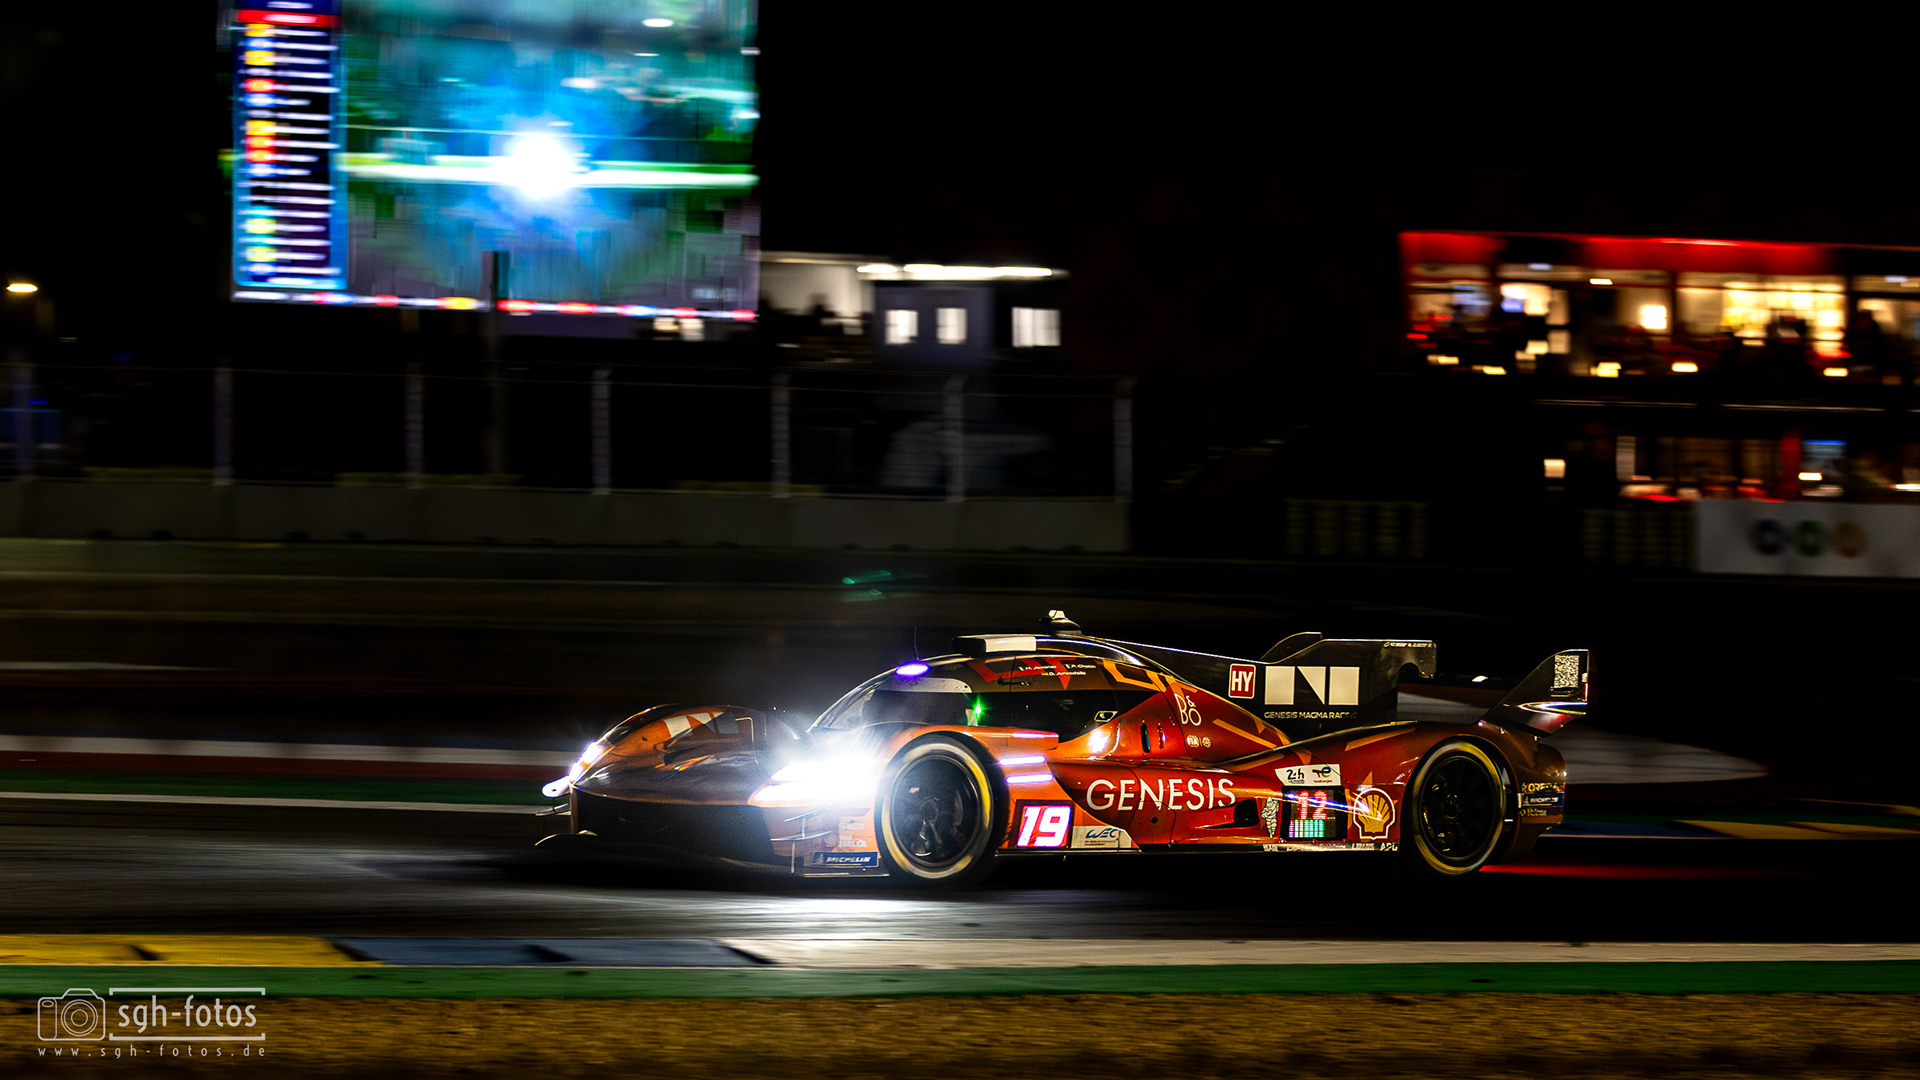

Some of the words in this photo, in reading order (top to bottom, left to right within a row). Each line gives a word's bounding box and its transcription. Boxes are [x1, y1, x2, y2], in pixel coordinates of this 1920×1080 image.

[1231, 670, 1254, 693] HY
[1263, 711, 1298, 719] GENESIS
[1298, 711, 1329, 719] MAGMA
[1086, 778, 1237, 811] GENESIS
[1298, 790, 1328, 820] 12
[1017, 805, 1072, 847] 19
[1085, 827, 1120, 839] WEC
